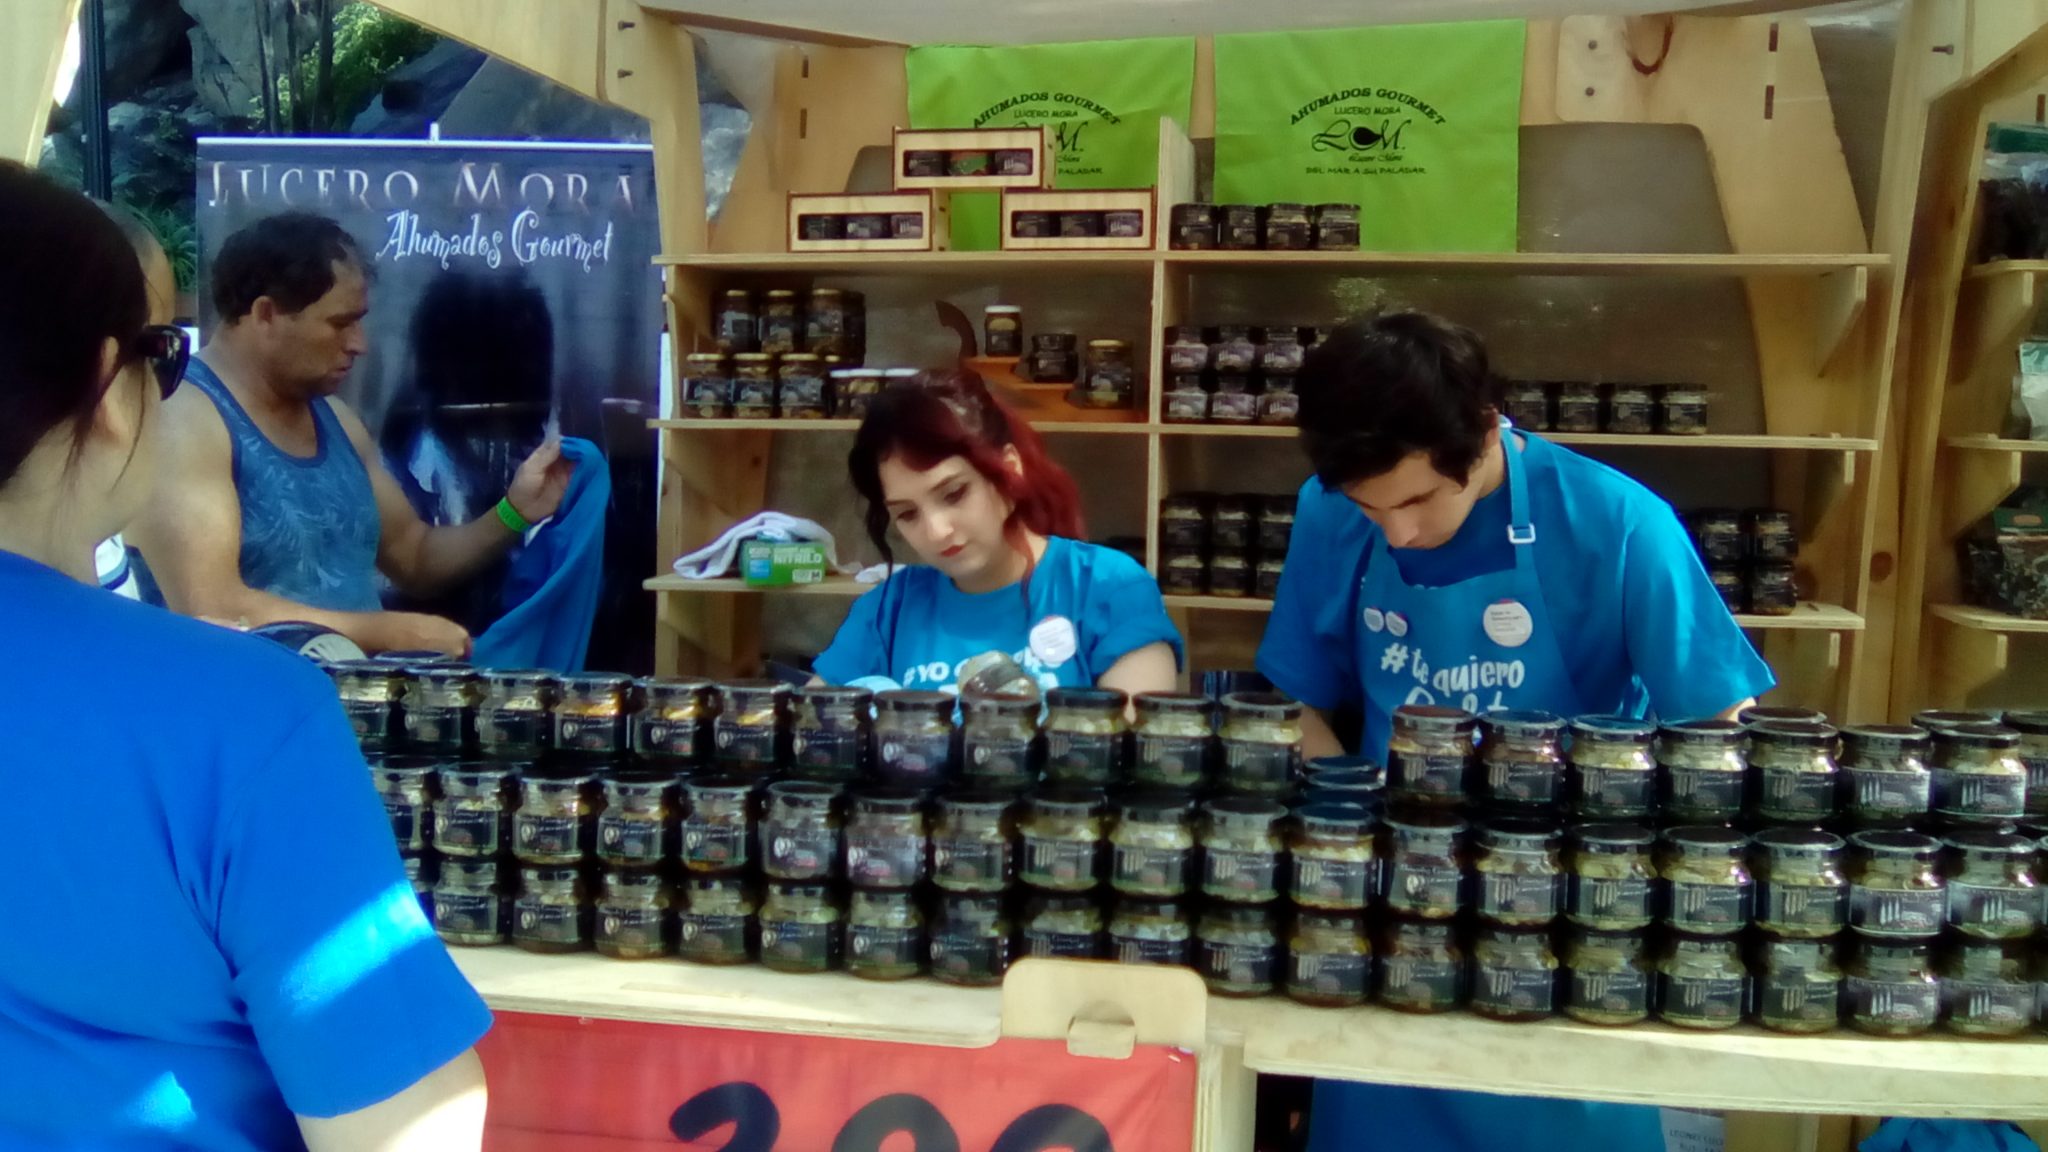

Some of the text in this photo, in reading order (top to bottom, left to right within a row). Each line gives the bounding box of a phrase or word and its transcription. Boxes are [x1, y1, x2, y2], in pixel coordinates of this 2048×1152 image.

[973, 91, 1121, 128] AHUMADOS GOURMET
[1014, 109, 1079, 119] LUCERO MORA
[1290, 87, 1446, 125] AHUMADOS GOURMET
[1334, 107, 1401, 115] LUCERO MORA
[209, 159, 637, 212] LUCERO MORA
[375, 206, 615, 272] Ahumados Gourmet
[1433, 655, 1525, 698] quiero
